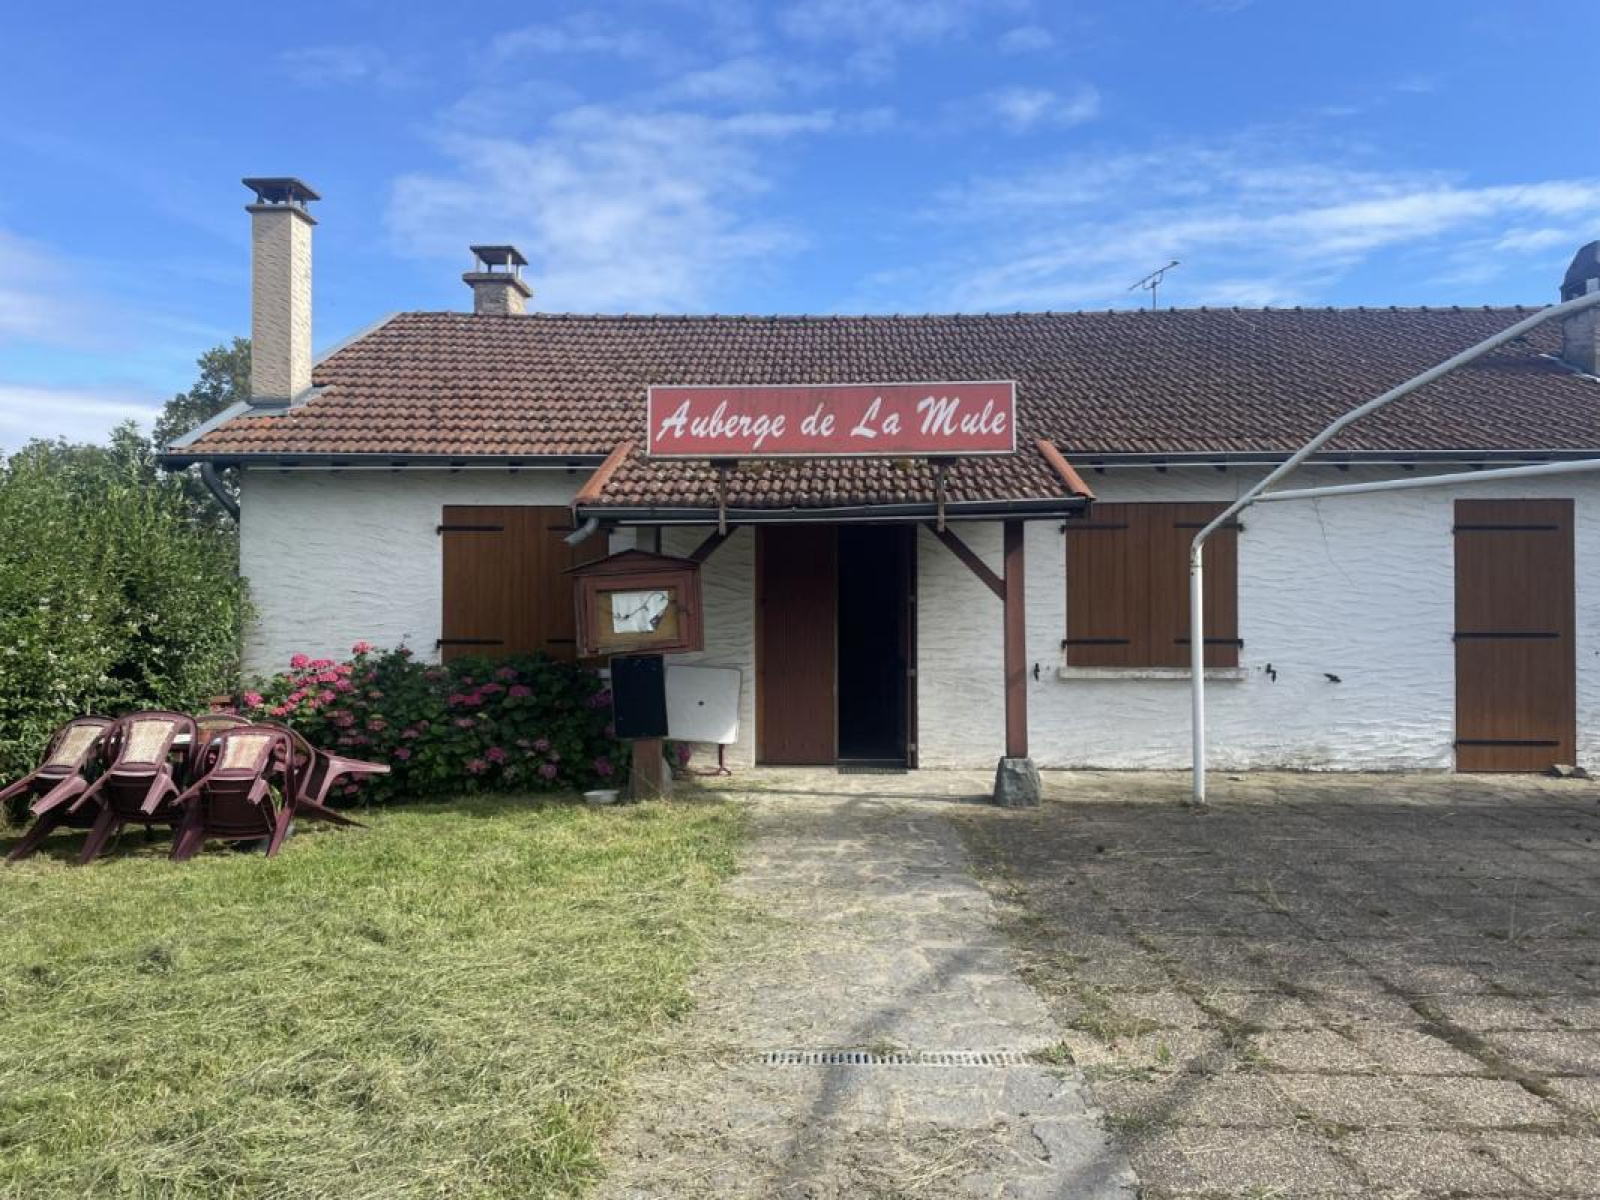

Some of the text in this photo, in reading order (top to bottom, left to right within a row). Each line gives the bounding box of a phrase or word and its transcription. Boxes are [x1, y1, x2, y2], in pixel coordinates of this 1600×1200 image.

[655, 396, 1006, 449] Auberge de La Mule
